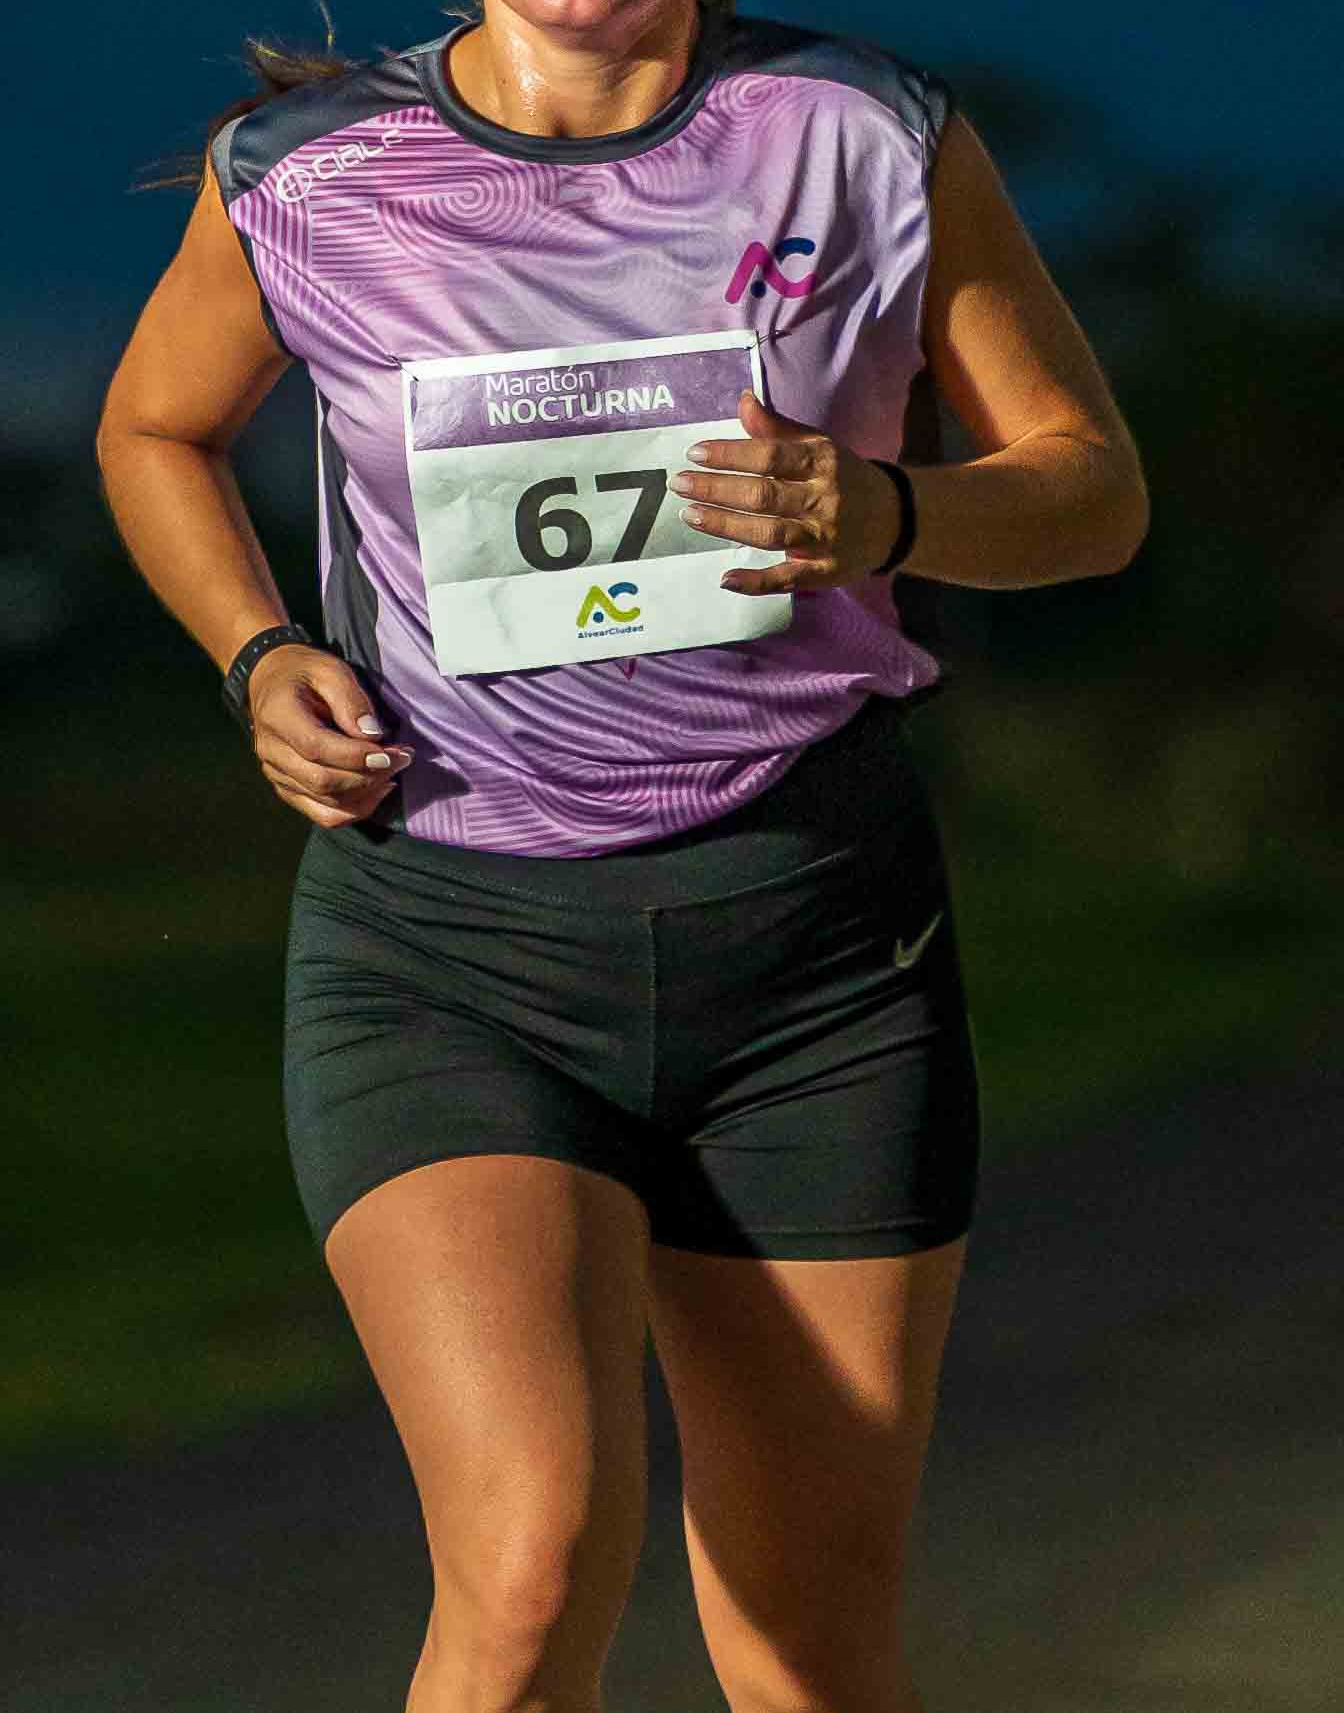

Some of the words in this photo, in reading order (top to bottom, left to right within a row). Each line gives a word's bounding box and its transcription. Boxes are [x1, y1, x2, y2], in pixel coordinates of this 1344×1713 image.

[485, 366, 595, 398] Maratón
[486, 384, 675, 427] NOCTURNA
[514, 468, 668, 572] 67
